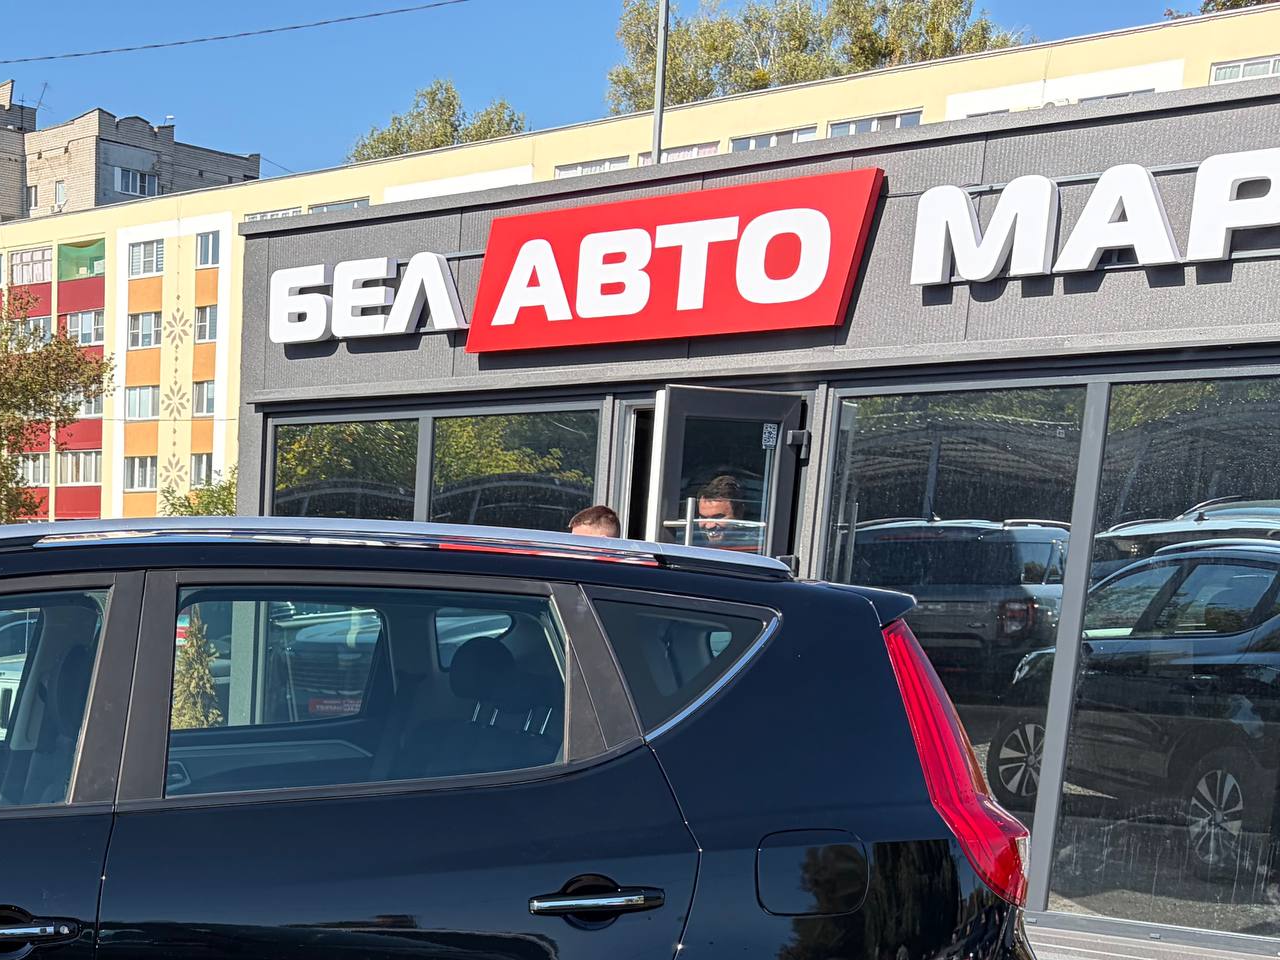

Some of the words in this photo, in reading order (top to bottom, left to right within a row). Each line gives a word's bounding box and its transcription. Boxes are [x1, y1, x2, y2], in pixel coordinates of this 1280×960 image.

[269, 251, 466, 344] БЕЛ
[490, 207, 832, 326] АВТО
[910, 147, 1280, 285] МАР
